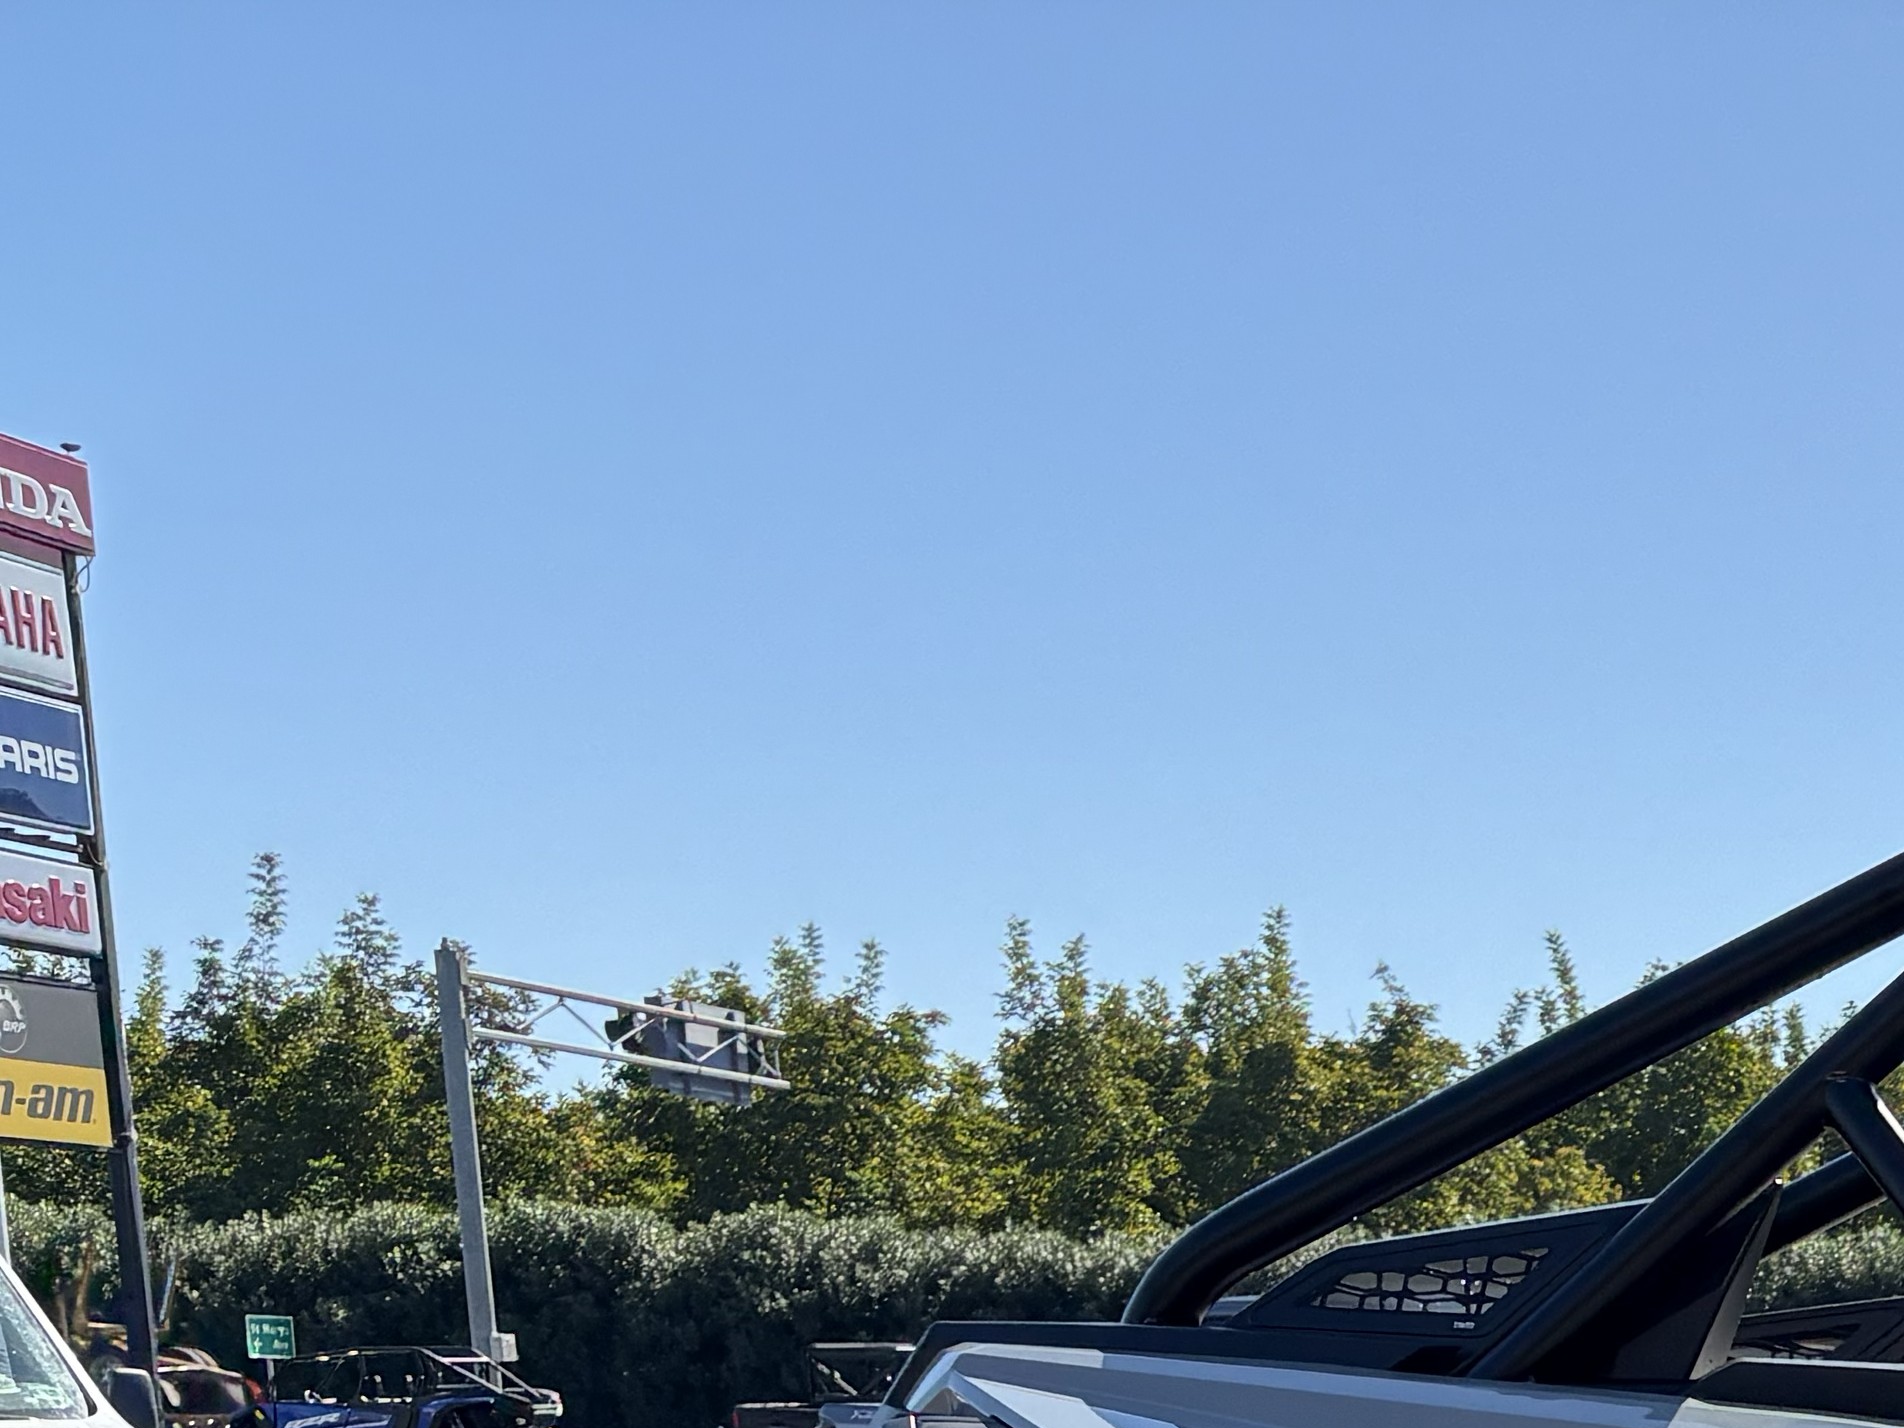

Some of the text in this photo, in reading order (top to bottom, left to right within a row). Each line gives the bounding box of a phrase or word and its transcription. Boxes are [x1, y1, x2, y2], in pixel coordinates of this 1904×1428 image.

[0, 467, 92, 537] DA
[0, 735, 79, 784] ARIS
[0, 875, 90, 934] saki
